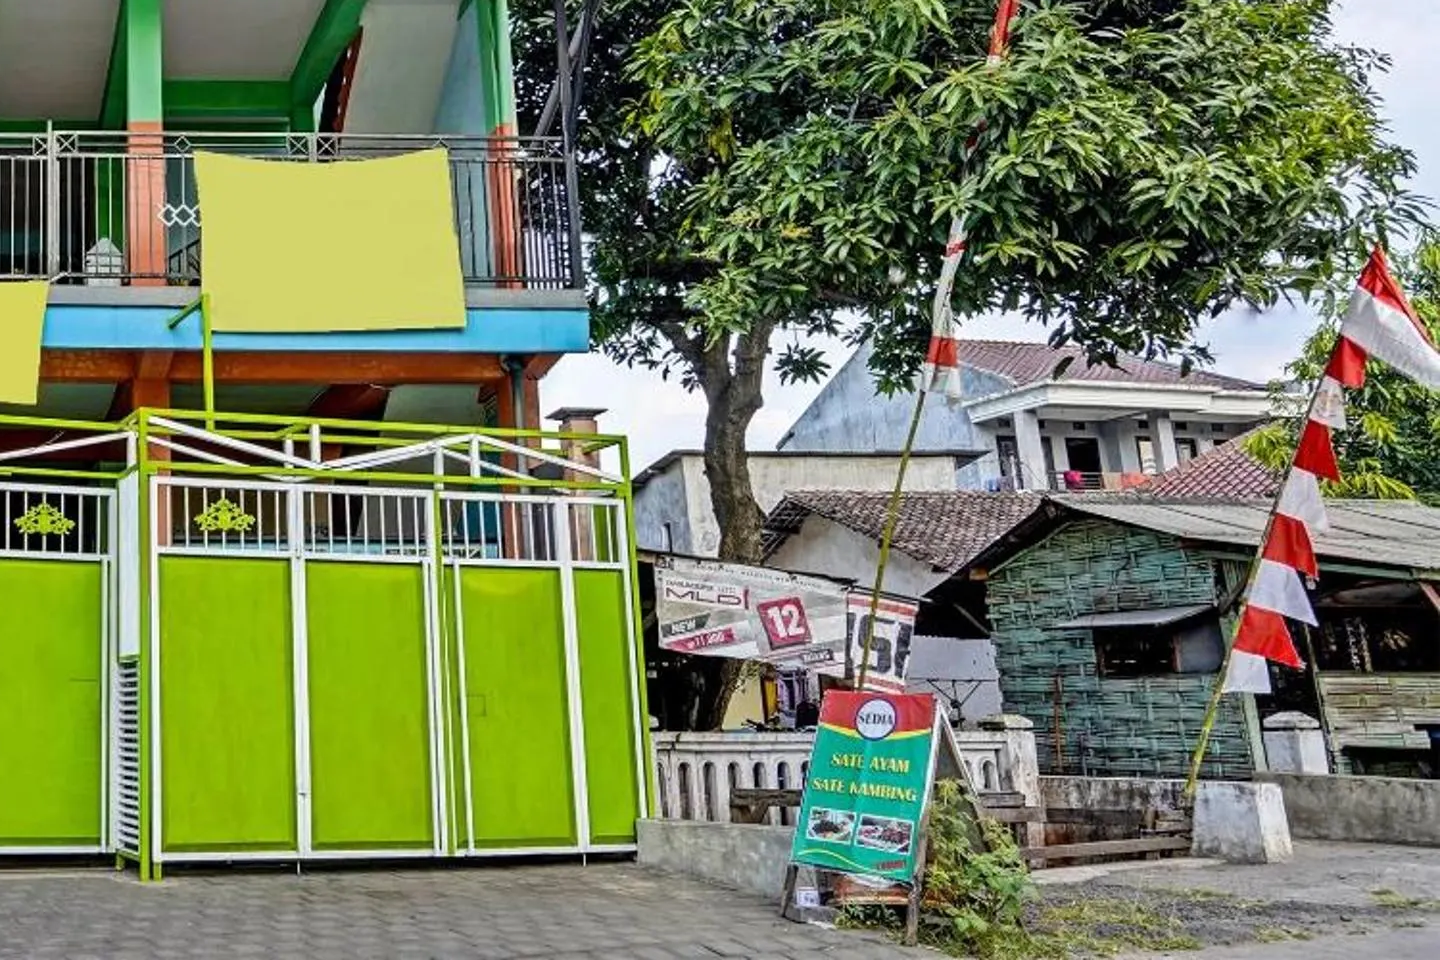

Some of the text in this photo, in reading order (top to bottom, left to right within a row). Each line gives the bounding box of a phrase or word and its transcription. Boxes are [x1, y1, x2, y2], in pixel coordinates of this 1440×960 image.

[666, 587, 741, 607] MLD
[671, 618, 696, 635] NEW
[768, 605, 805, 639] 12
[859, 713, 893, 725] SEDIA
[831, 753, 910, 773] SATE AYAM
[812, 778, 917, 802] SATE KAMBING
